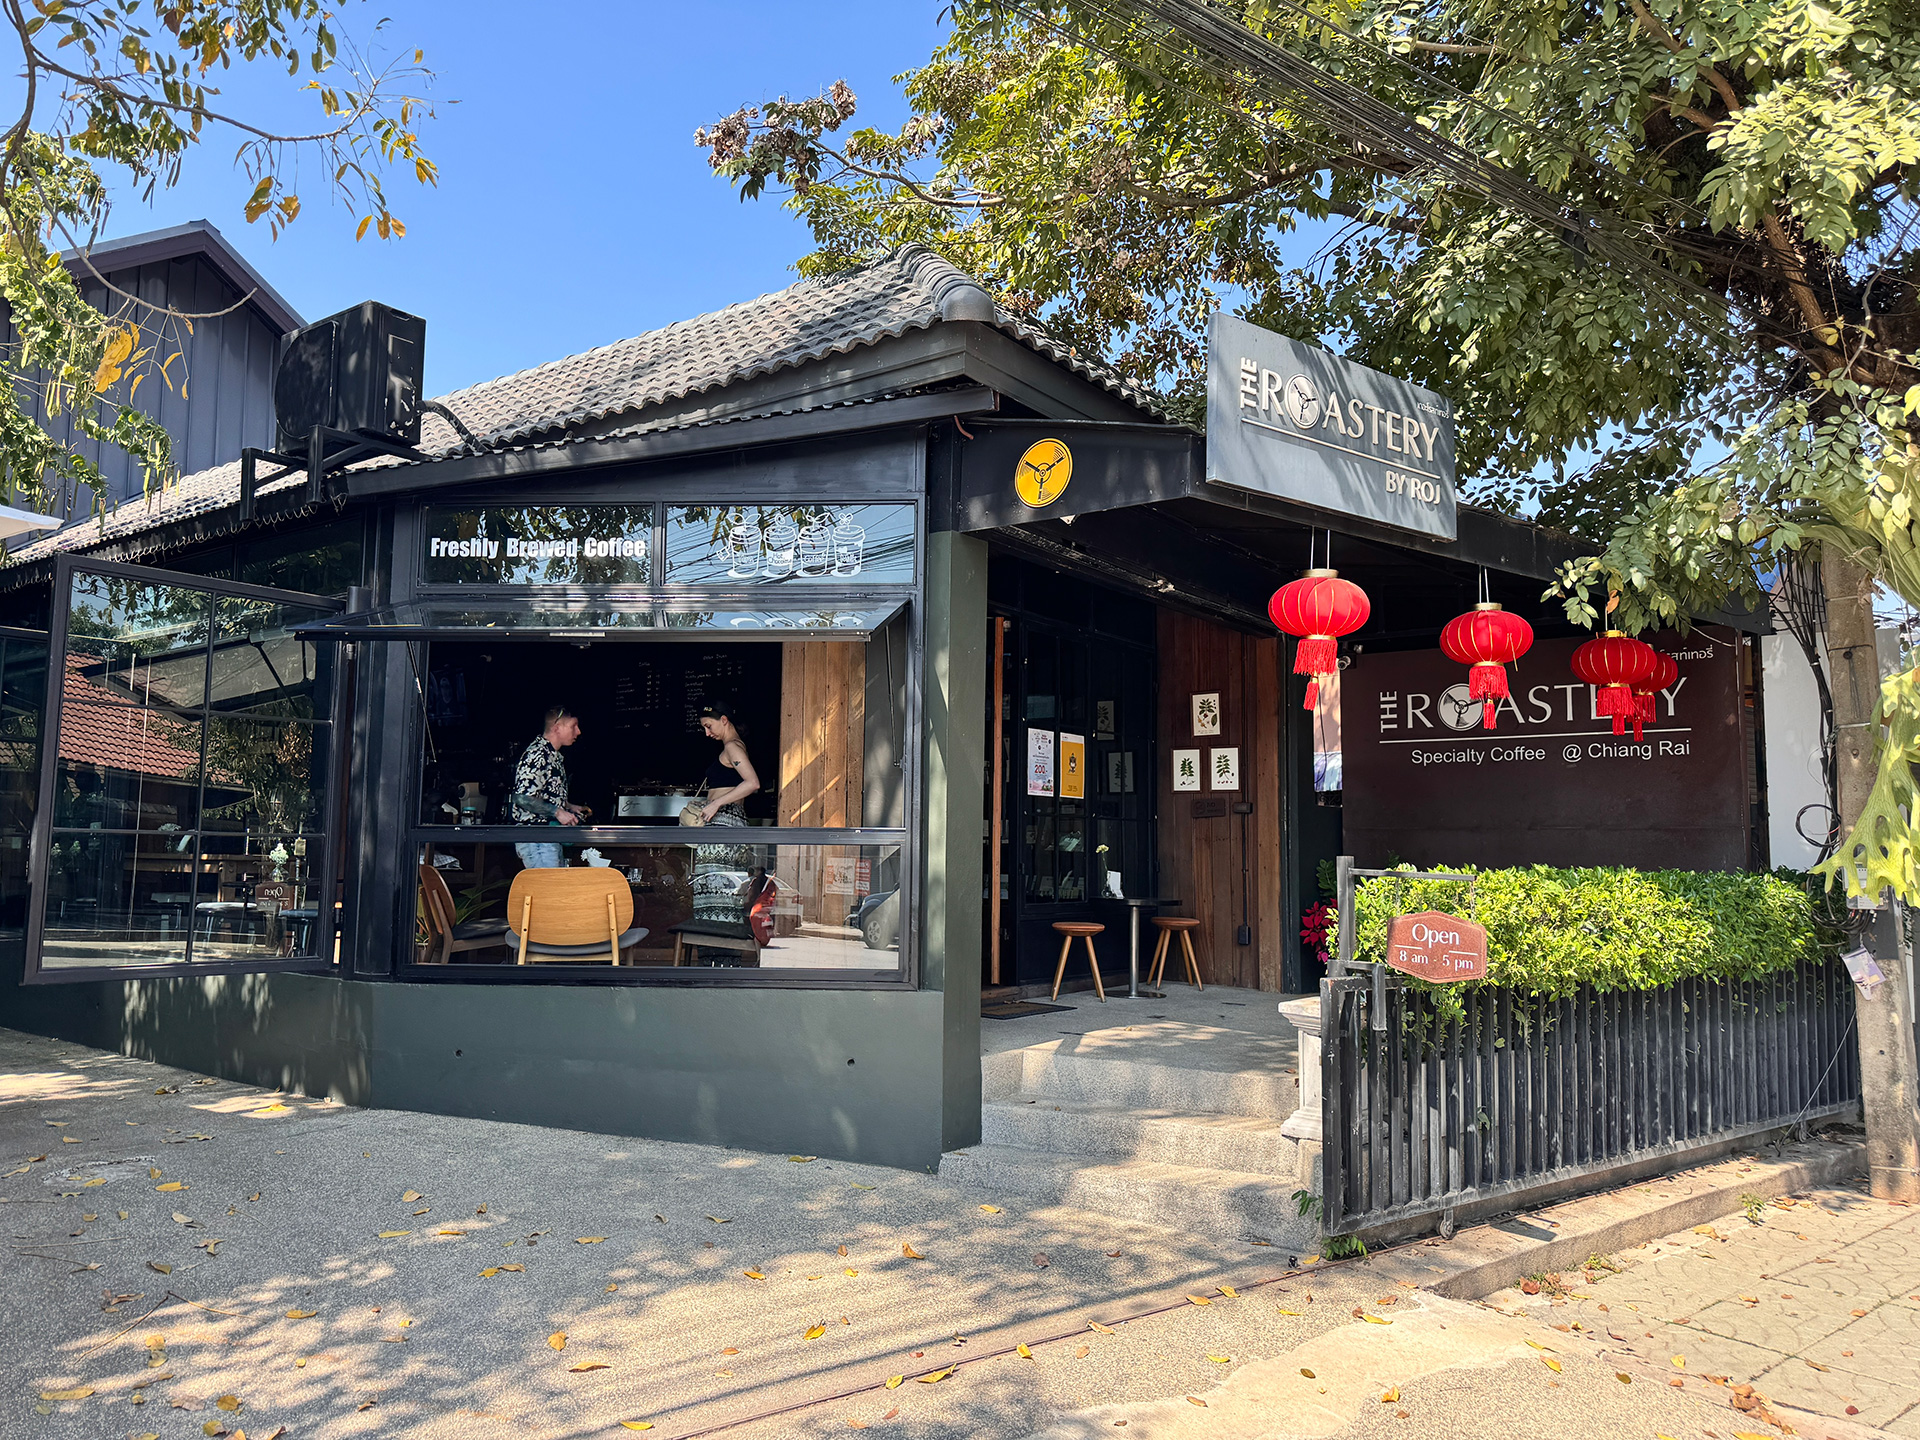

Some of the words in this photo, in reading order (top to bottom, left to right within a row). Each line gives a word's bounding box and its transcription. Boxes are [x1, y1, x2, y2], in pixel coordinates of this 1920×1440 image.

[1240, 357, 1257, 409] THE
[1262, 368, 1439, 462] ROASTERY
[1386, 470, 1406, 495] BY
[1411, 477, 1440, 505] ROJ
[430, 537, 499, 559] Freshly
[507, 537, 578, 557] Brewed
[584, 537, 646, 557] Coffee
[1380, 690, 1398, 733] THE
[1407, 677, 1688, 731] ROASTEY
[1411, 748, 1485, 766] Specialty
[1490, 745, 1546, 762] Coffee
[1562, 743, 1582, 761] @
[1588, 742, 1652, 760] Chiang
[1659, 739, 1690, 756] Rai
[1412, 923, 1460, 949] Open
[1399, 950, 1407, 962] 8
[1411, 953, 1429, 965] am
[1442, 954, 1450, 967] 5
[1454, 959, 1474, 972] pm
